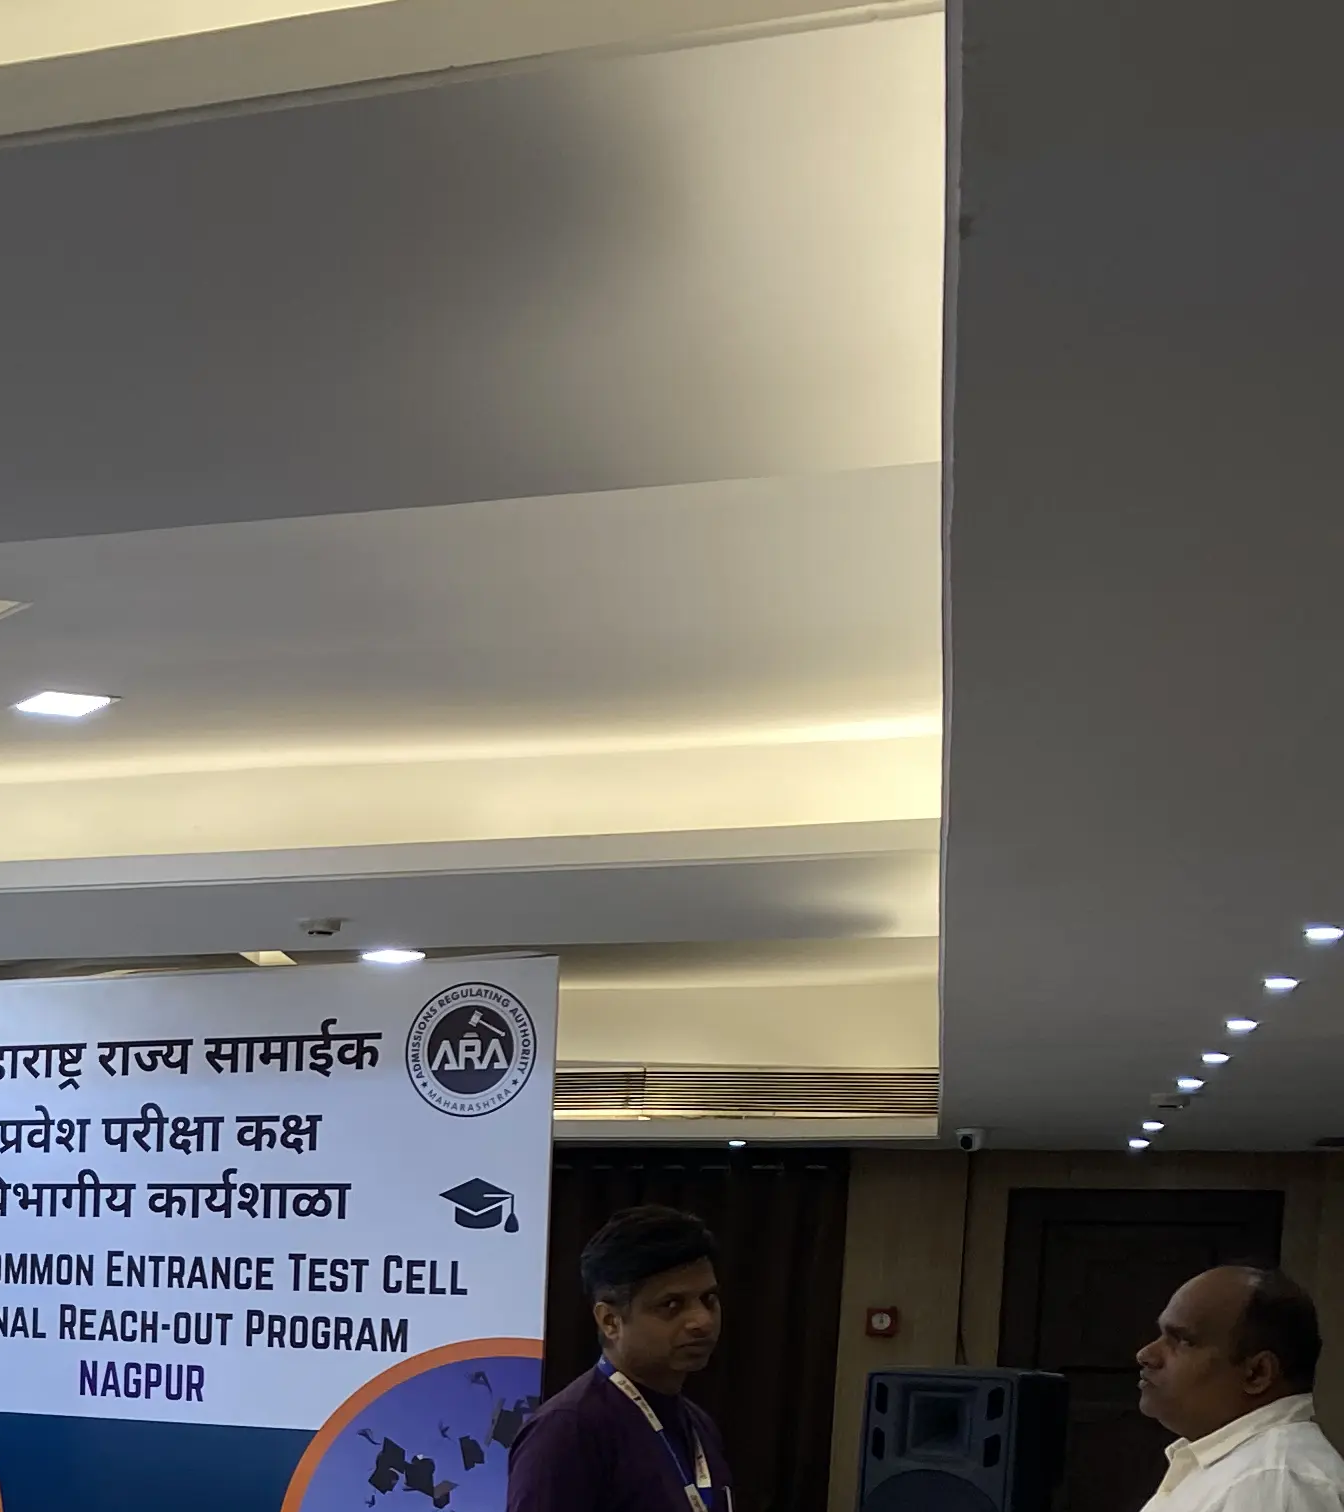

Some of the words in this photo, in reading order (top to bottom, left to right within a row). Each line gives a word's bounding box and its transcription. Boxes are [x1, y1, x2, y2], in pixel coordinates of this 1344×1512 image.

[96, 1036, 195, 1078] राज्य
[204, 1017, 384, 1078] सामाईक
[412, 1006, 437, 1079] ADMISSIONS
[437, 988, 511, 1008] REGULATING
[509, 1007, 531, 1075] AUTHORITY
[431, 1032, 509, 1071] ARA
[427, 1088, 513, 1112] MAHARASHTRA
[102, 1101, 224, 1155] परीक्षा
[235, 1109, 323, 1155] कक्ष
[146, 1166, 352, 1221] कार्यशाळा
[106, 1250, 275, 1291] ENTRANCE
[287, 1252, 369, 1295] TEST
[382, 1254, 469, 1297] CELL
[58, 1303, 233, 1347] REACH-OUT
[245, 1309, 409, 1354] PROGRAM
[78, 1359, 206, 1402] NAGPUR
